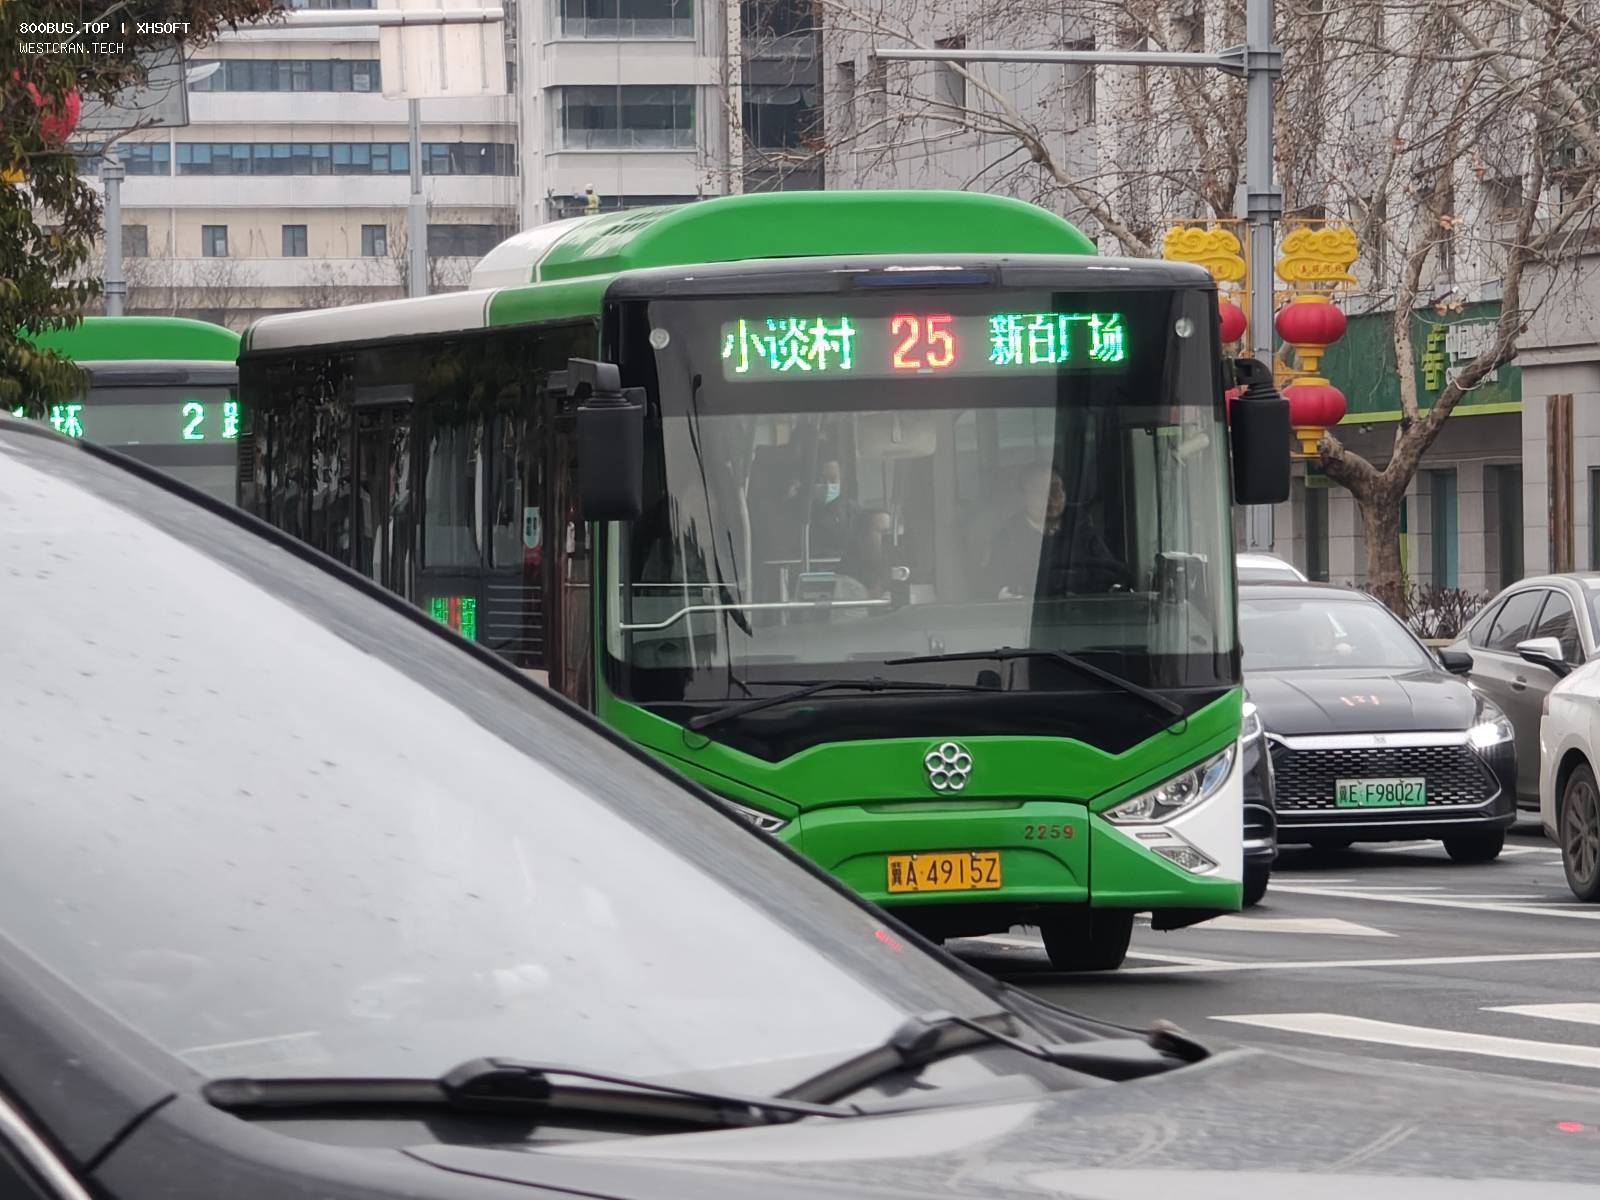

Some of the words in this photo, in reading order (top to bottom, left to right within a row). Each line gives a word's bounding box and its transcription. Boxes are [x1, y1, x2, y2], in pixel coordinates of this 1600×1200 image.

[722, 317, 855, 372] 小谈村
[891, 315, 955, 369] 25
[989, 313, 1125, 364] 新百广场
[182, 402, 205, 440] 2
[1024, 825, 1074, 840] 2259
